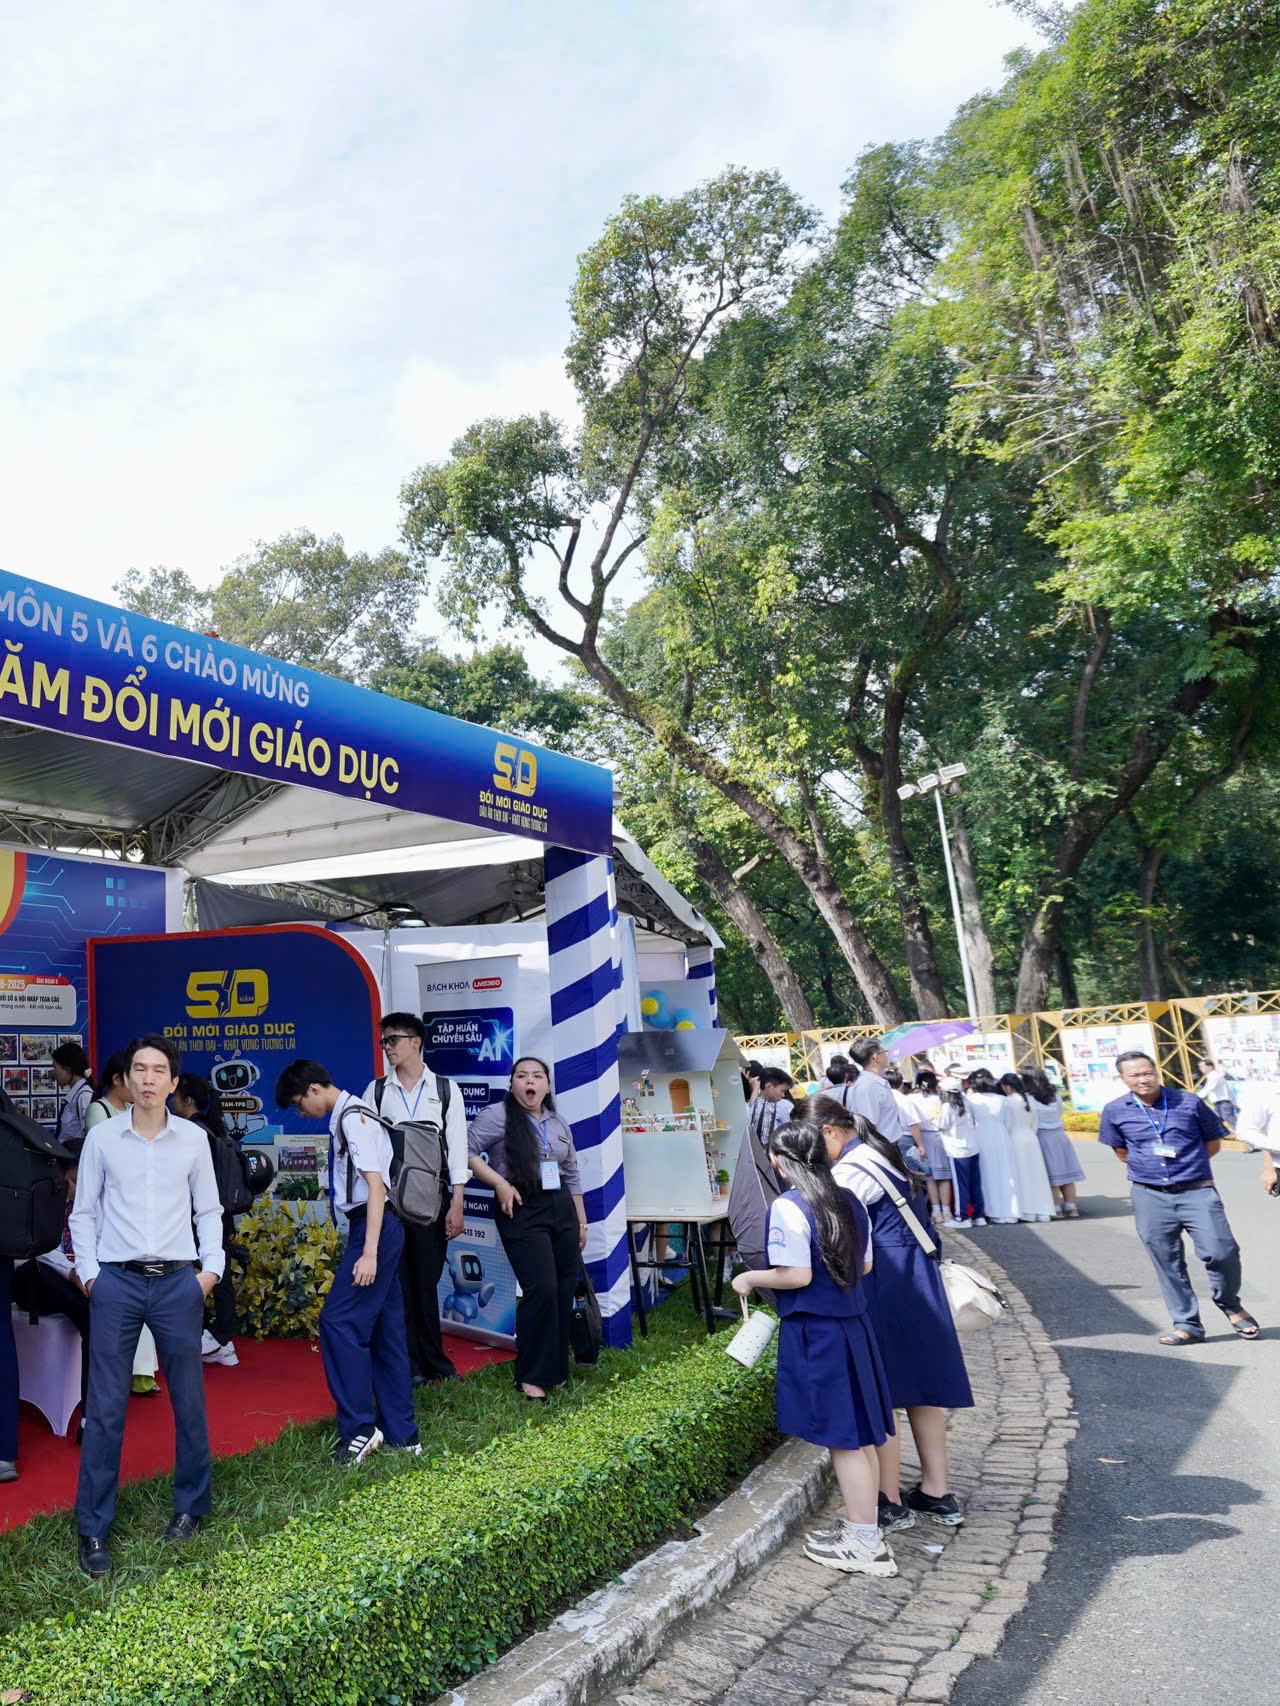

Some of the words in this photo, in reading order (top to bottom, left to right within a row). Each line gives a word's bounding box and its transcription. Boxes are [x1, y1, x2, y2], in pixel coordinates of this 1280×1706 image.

[71, 611, 88, 643] 5
[96, 616, 134, 657] VÀ
[141, 634, 158, 663] 6
[165, 641, 237, 686] CHÀO
[242, 664, 310, 708] MỪNG
[81, 666, 158, 736] ĐỔI
[169, 697, 240, 757] MỚI
[249, 720, 331, 777] GIÁO
[338, 744, 400, 800] DỤC
[512, 800, 531, 815] GIÁO
[532, 805, 548, 820] DỤC
[448, 981, 470, 990] KHOA
[163, 1022, 187, 1038] ĐỔI
[192, 1023, 220, 1037] MỚI
[224, 1022, 259, 1036] GIÁO
[264, 1023, 295, 1038] DỤC
[437, 1022, 454, 1034] TẬP
[455, 1020, 478, 1033] HUẤN
[432, 1033, 465, 1044] CHUYÊN
[466, 1031, 482, 1043] SÂU
[478, 1038, 502, 1062] AI
[463, 1087, 486, 1098] DỤNG
[468, 1202, 489, 1211] NGAY!
[474, 1229, 486, 1239] 192
